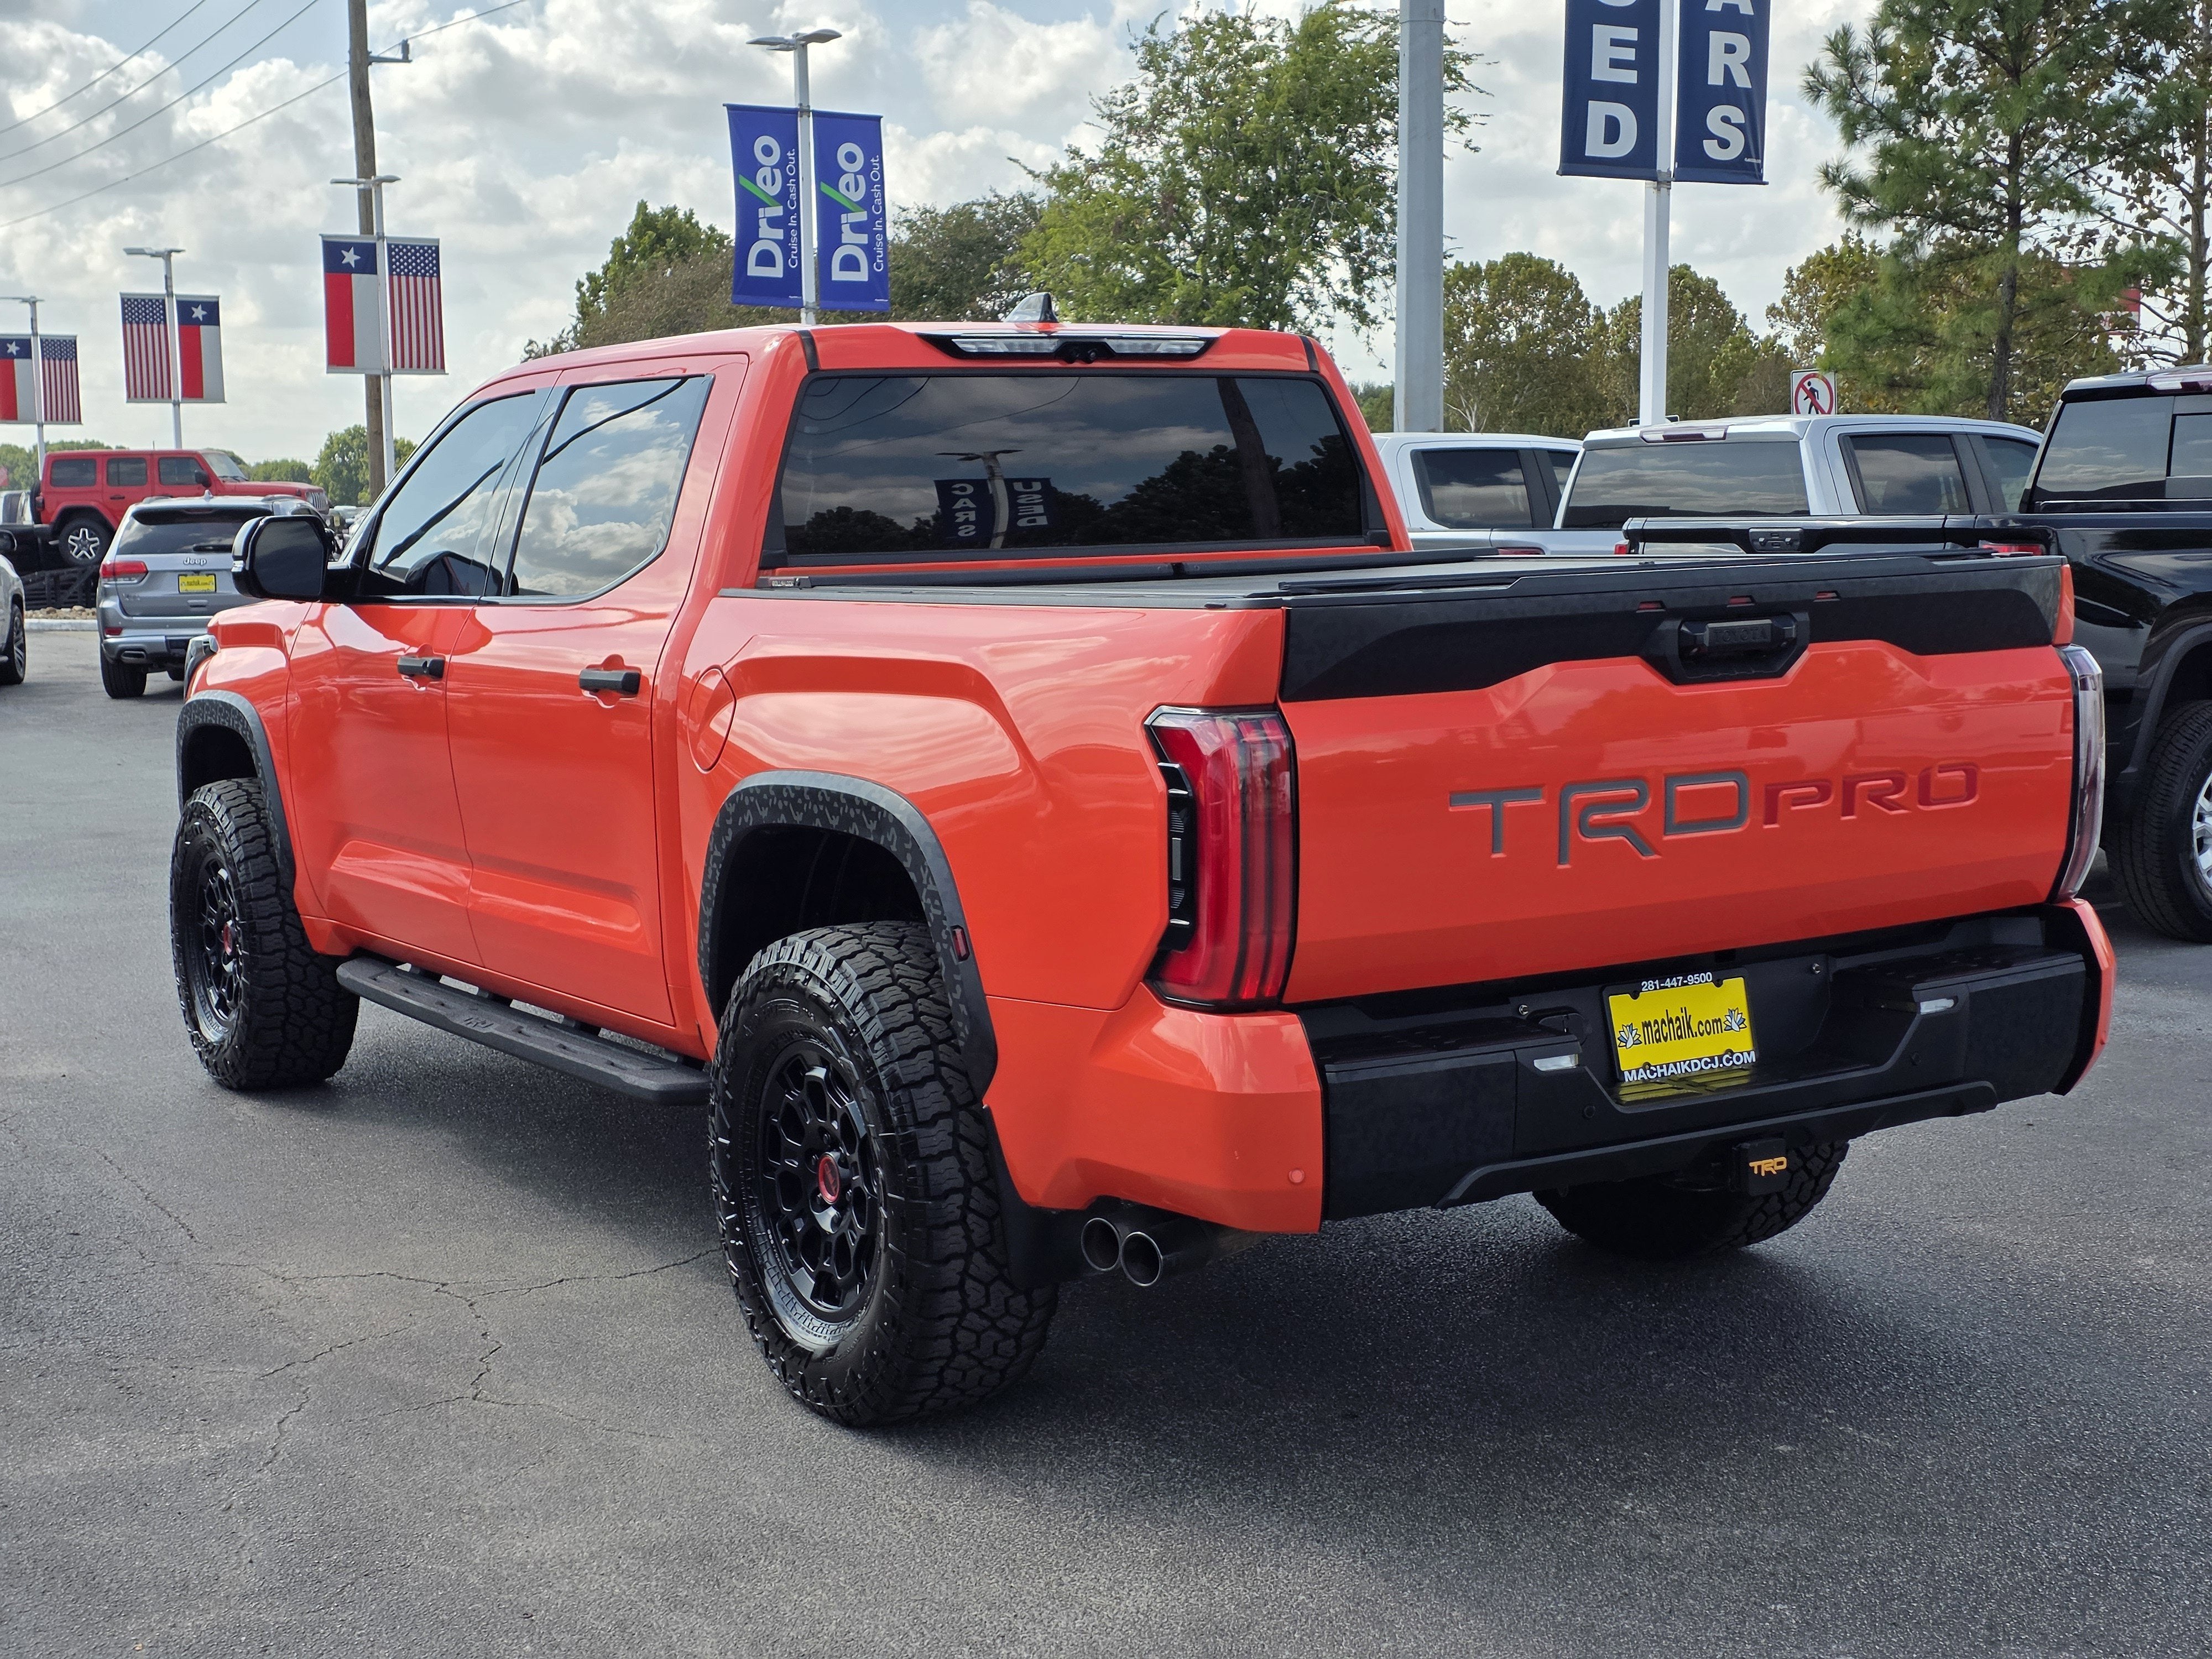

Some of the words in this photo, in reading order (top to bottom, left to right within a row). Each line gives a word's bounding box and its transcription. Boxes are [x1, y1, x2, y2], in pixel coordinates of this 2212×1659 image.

[1585, 0, 1639, 158] ED
[1703, 0, 1755, 160] RS
[786, 149, 796, 176] Out.
[870, 155, 880, 181] Out.
[739, 135, 784, 278] Driveo
[786, 179, 796, 210] Cash
[870, 184, 882, 215] Cash
[788, 212, 797, 226] In.
[821, 142, 868, 281] Driveo
[873, 217, 883, 231] In.
[788, 228, 798, 268] Cruise
[873, 233, 884, 272] Cruise
[1449, 769, 1751, 867] TRD
[1764, 761, 1980, 828] PRO
[1641, 972, 1713, 992] 281-447-9500
[1641, 1006, 1724, 1045] machaik.com
[1624, 1050, 1756, 1082] MACHAIKDCJ.COM
[1749, 1156, 1787, 1176] TRD
